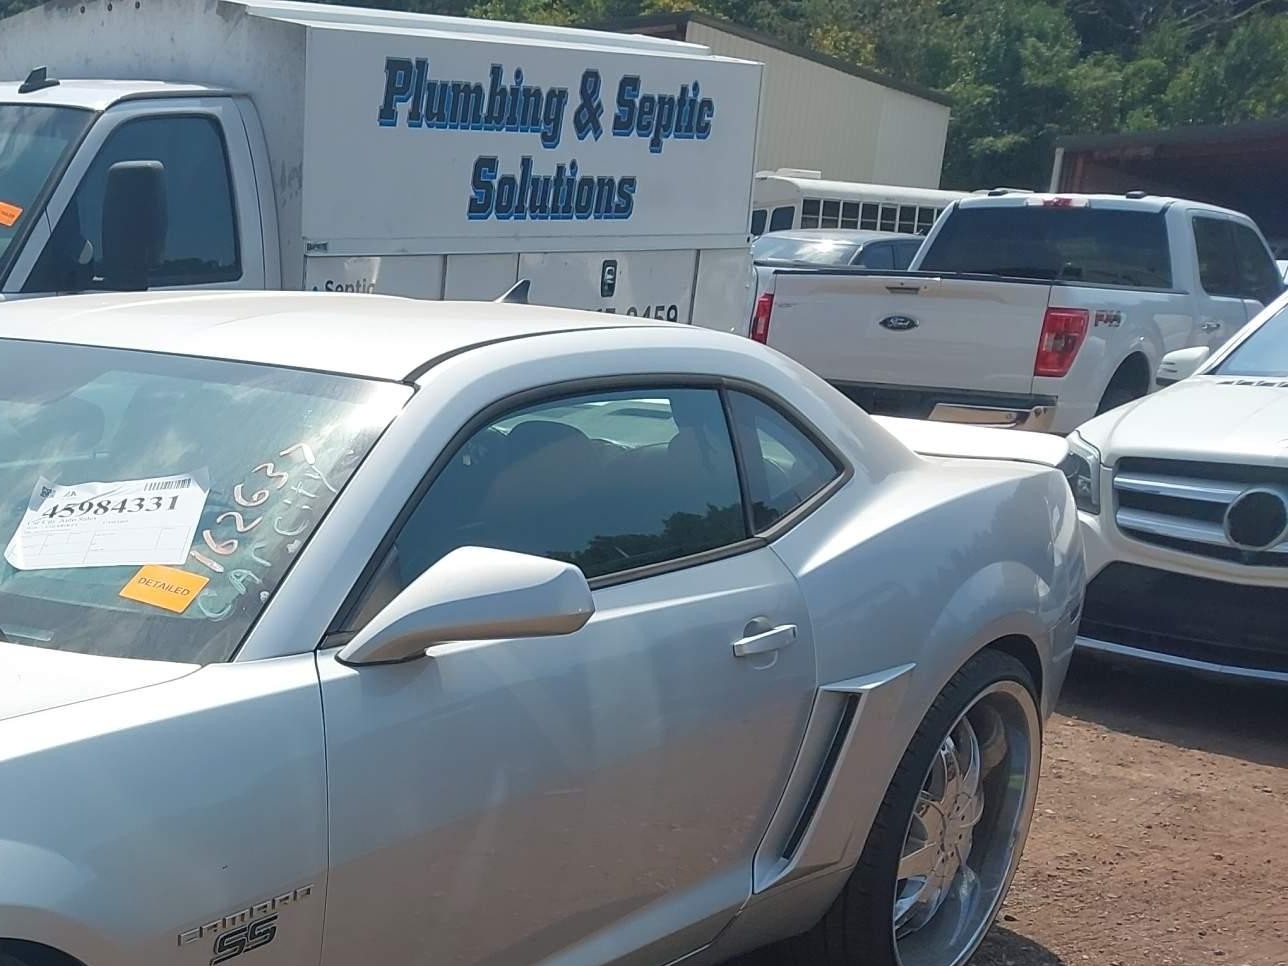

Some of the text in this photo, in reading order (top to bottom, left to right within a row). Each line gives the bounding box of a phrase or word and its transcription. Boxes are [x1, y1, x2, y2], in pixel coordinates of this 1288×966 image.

[377, 56, 715, 154] Plumbing & Septic
[466, 155, 637, 220] Solutions
[38, 495, 180, 520] 45984331
[188, 442, 317, 574] 162637
[137, 575, 191, 597] DETAILED
[209, 911, 279, 966] SS
